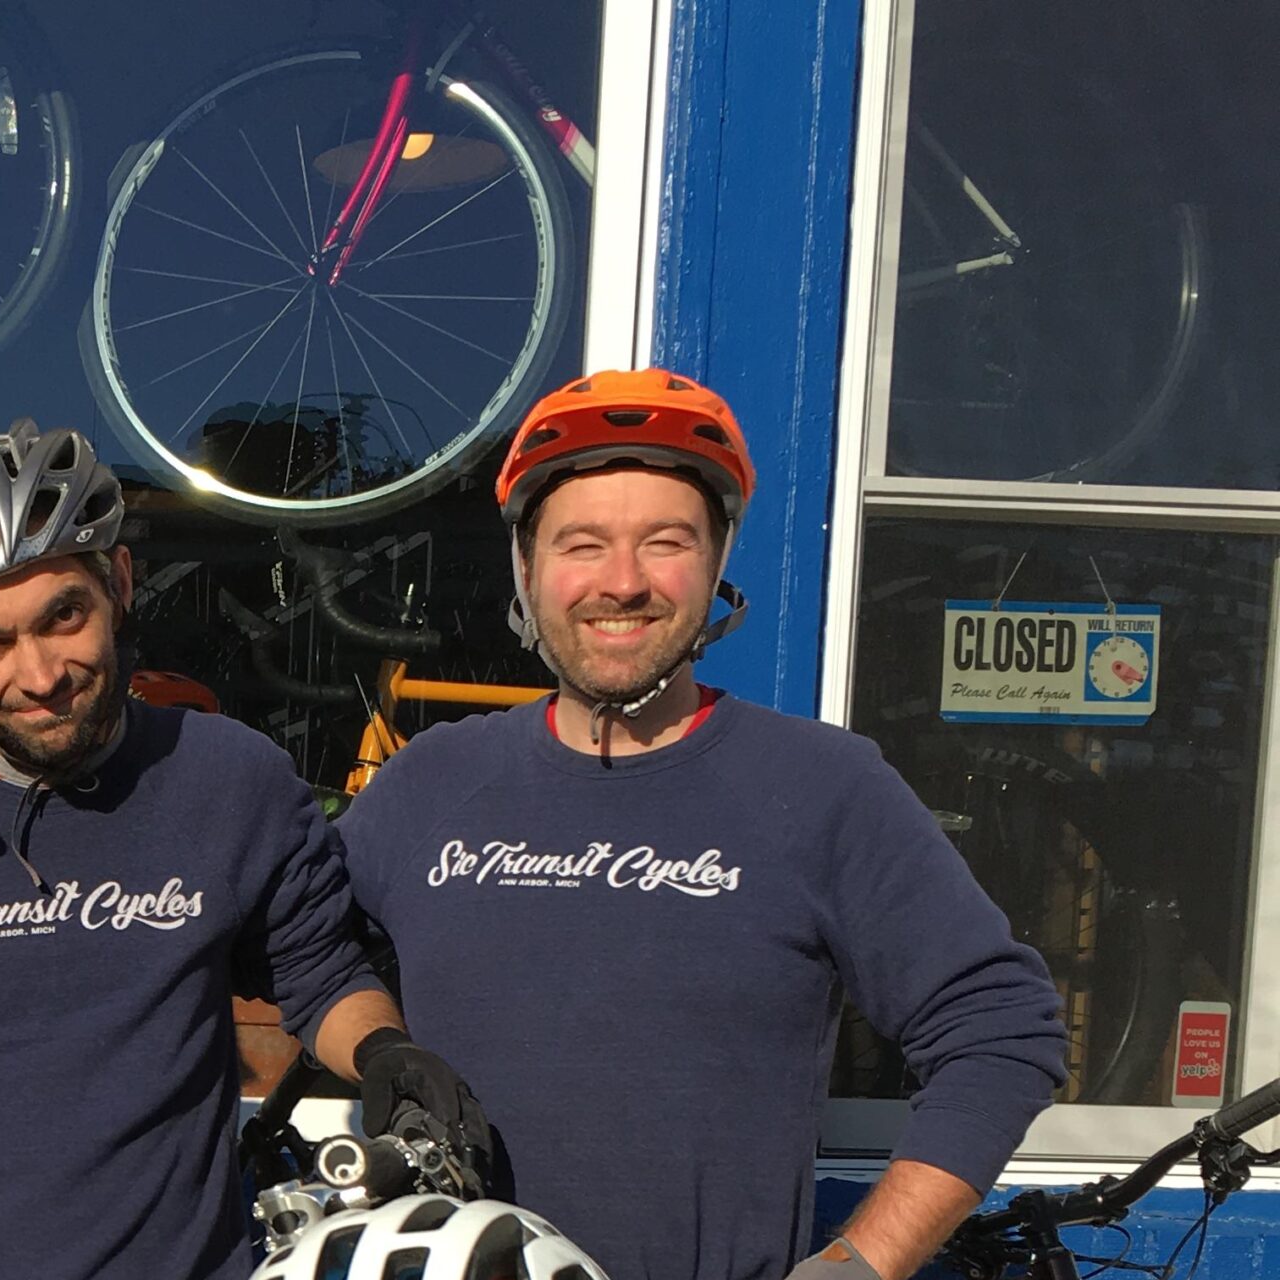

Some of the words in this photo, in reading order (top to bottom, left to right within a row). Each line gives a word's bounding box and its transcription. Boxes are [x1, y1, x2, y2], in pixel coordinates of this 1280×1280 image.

[1088, 619, 1111, 631] WILL
[1114, 620, 1155, 631] RETURN
[953, 616, 1076, 673] CLOSED
[951, 683, 992, 698] Please
[996, 684, 1027, 700] Call
[1030, 685, 1071, 703] Again
[428, 840, 478, 887] Sic
[476, 841, 614, 885] Transit
[607, 846, 742, 897] Cycles
[498, 879, 517, 887] ANN
[555, 879, 580, 888] MICH
[80, 877, 204, 931] Cycles
[31, 926, 56, 935] MICH
[1186, 1028, 1220, 1037] PEOPLE
[1183, 1039, 1207, 1048] LOVE
[1194, 1051, 1209, 1059] ON
[1181, 1063, 1209, 1079] yelp
